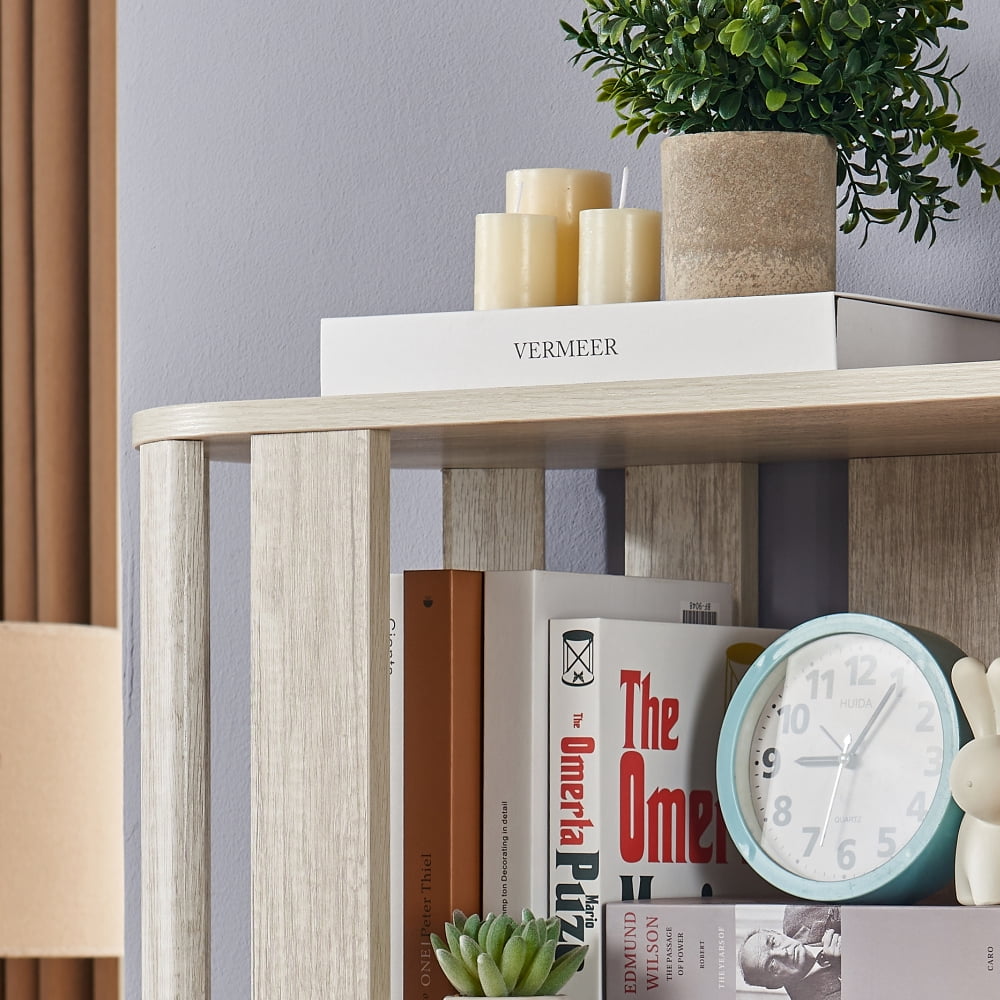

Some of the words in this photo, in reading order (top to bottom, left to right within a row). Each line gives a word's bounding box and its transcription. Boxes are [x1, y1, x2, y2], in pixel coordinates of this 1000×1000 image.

[513, 337, 619, 360] VERMEER
[805, 669, 834, 699] 11
[845, 655, 877, 685] 12
[619, 669, 680, 751] The
[777, 703, 810, 734] 10
[839, 699, 873, 709] HUIDA
[915, 703, 935, 732] 2
[573, 713, 584, 729] The
[762, 747, 781, 779] 9
[923, 746, 941, 777] 3
[560, 736, 596, 846] Omerta
[906, 791, 926, 821] 4
[619, 751, 729, 864] Omer
[772, 795, 792, 826] 8
[501, 826, 508, 834] in
[802, 827, 821, 857] 7
[877, 827, 896, 858] 5
[501, 836, 509, 881] Decorating
[836, 839, 856, 870] 6
[421, 853, 432, 893] Thiel
[421, 899, 432, 940] Peter
[556, 848, 600, 972] Puz
[585, 895, 599, 929] Mario
[718, 927, 725, 939] OF
[421, 947, 431, 986] ONE
[624, 911, 637, 994] EDMUND
[646, 916, 659, 991] WILSON
[678, 965, 684, 976] OF
